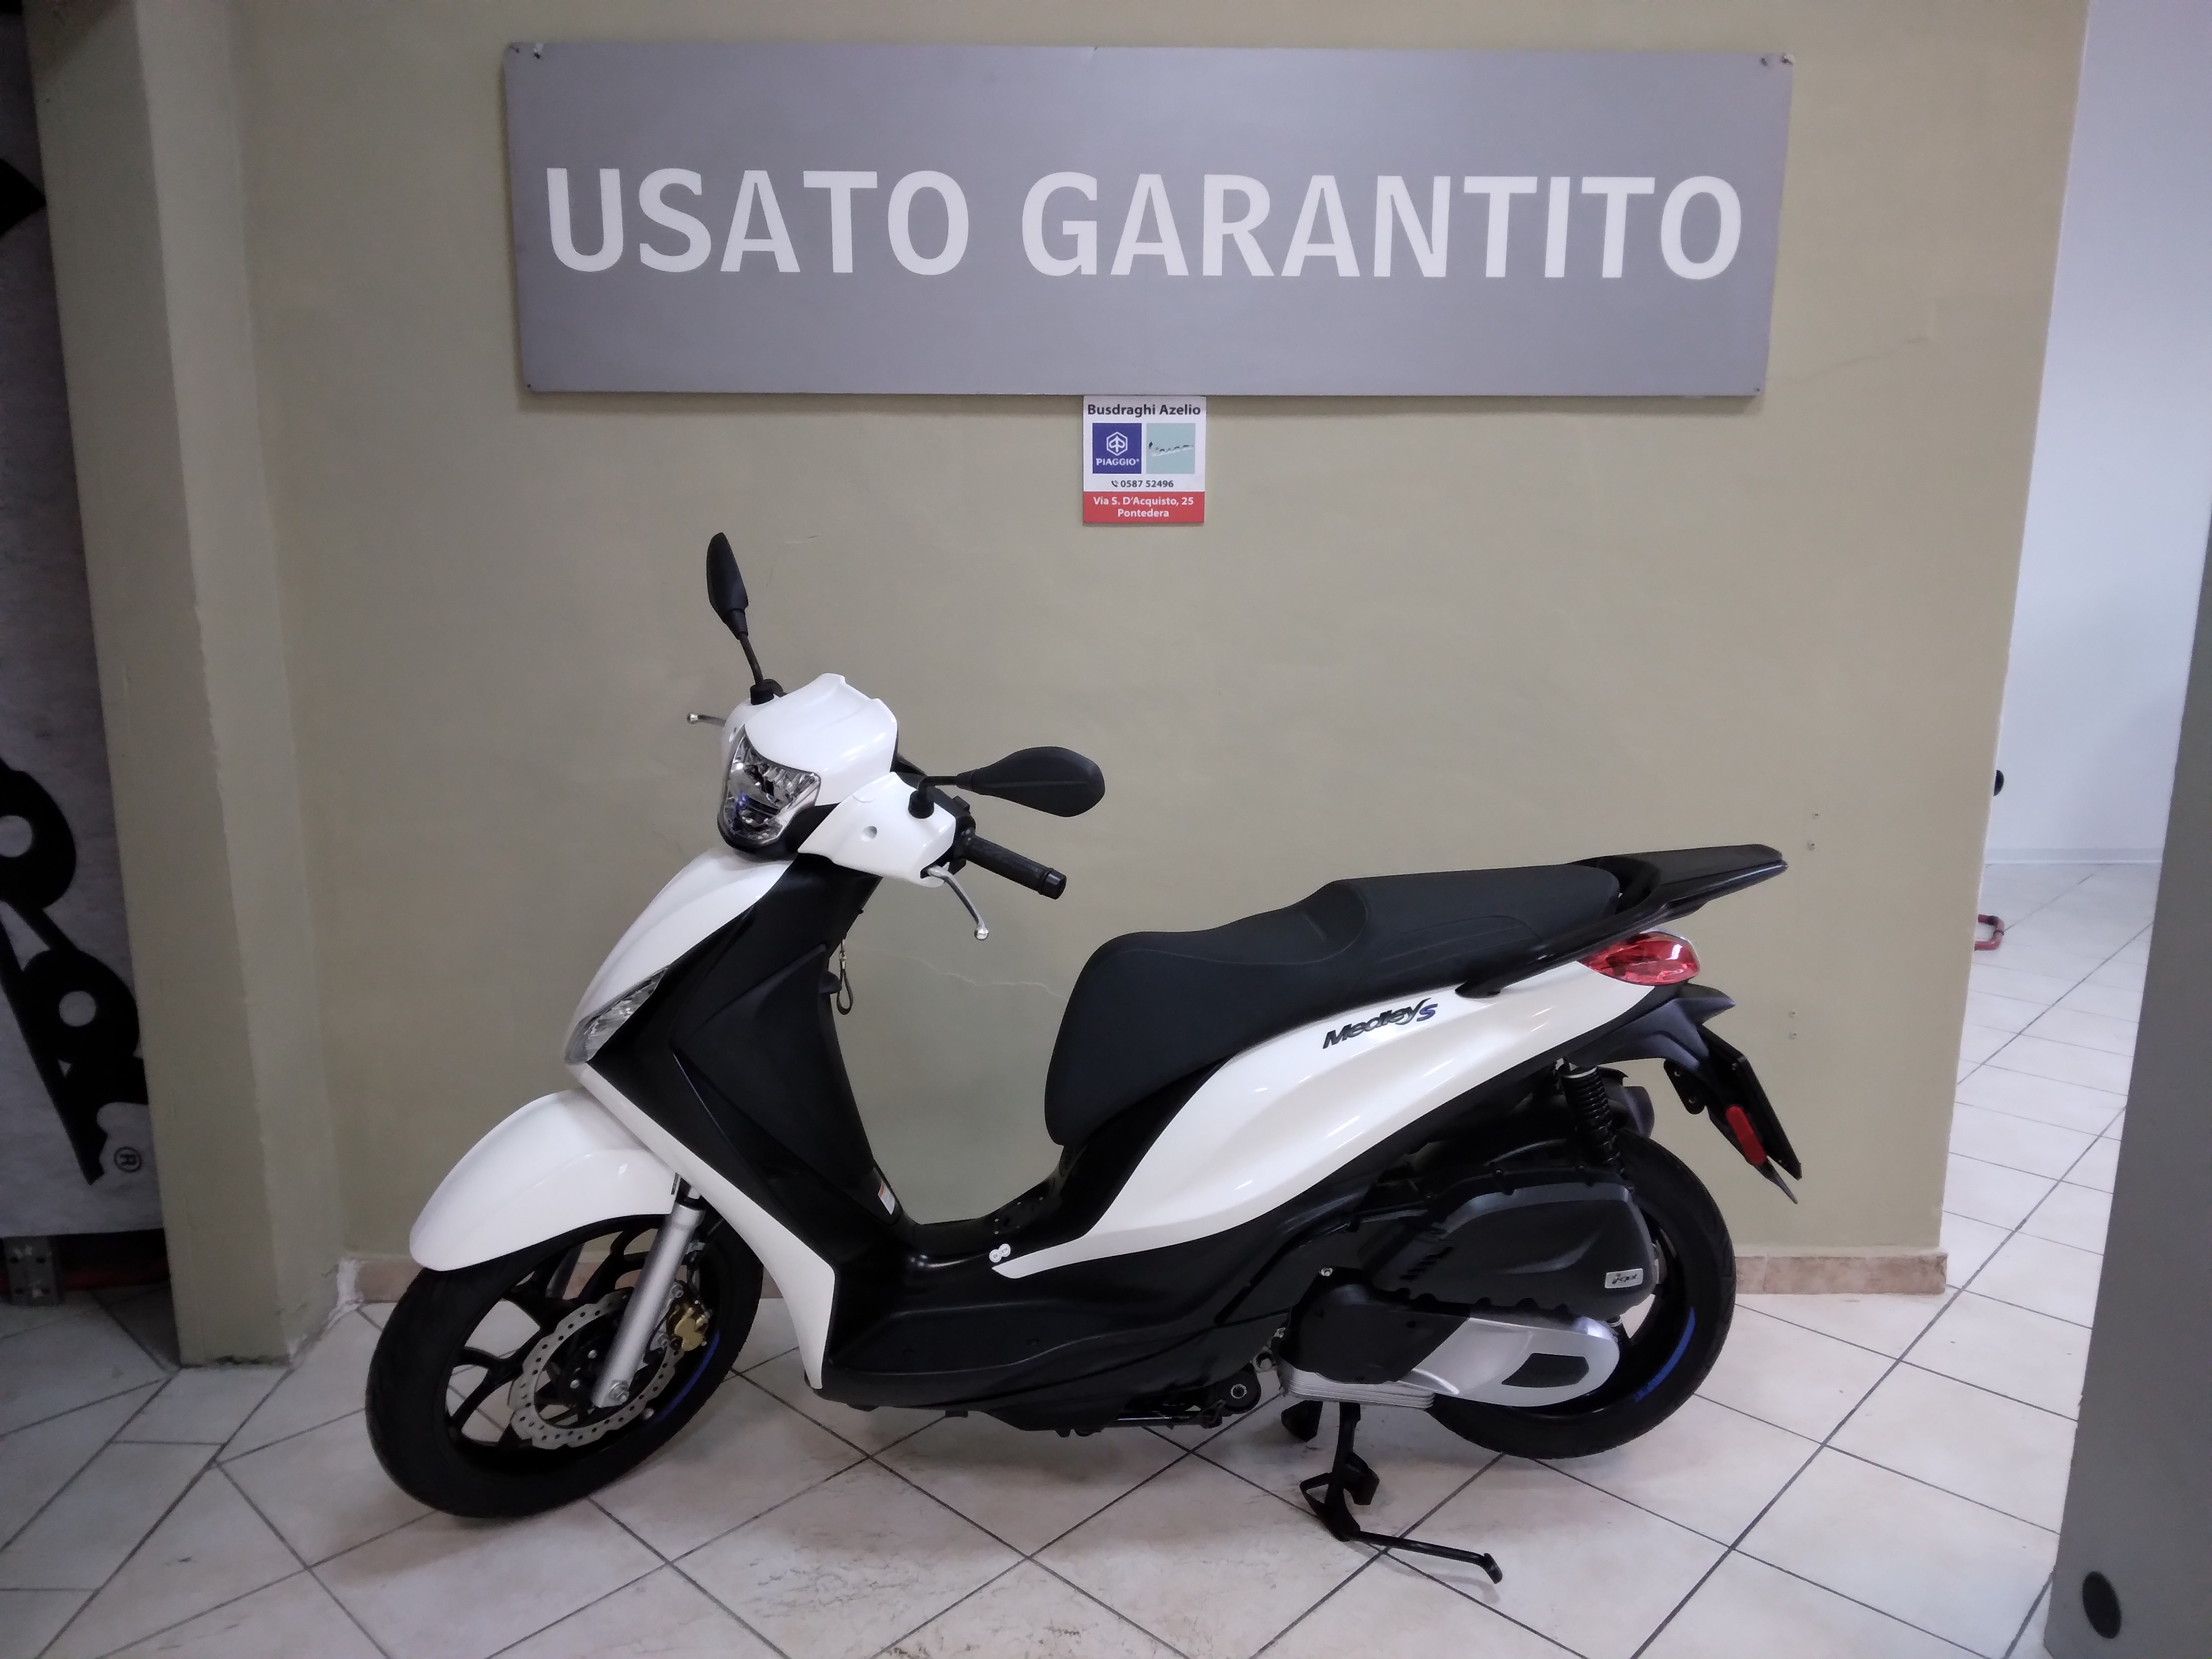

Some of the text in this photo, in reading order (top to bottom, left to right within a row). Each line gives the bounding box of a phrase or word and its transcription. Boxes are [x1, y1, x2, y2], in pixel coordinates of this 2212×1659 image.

[547, 167, 1742, 280] USATO GARANTITO
[1087, 404, 1201, 417] Busdraghi Azelio
[1093, 497, 1109, 505] Via
[1111, 497, 1121, 505] S.
[1182, 497, 1194, 505] 25
[1118, 508, 1169, 517] Pontedera
